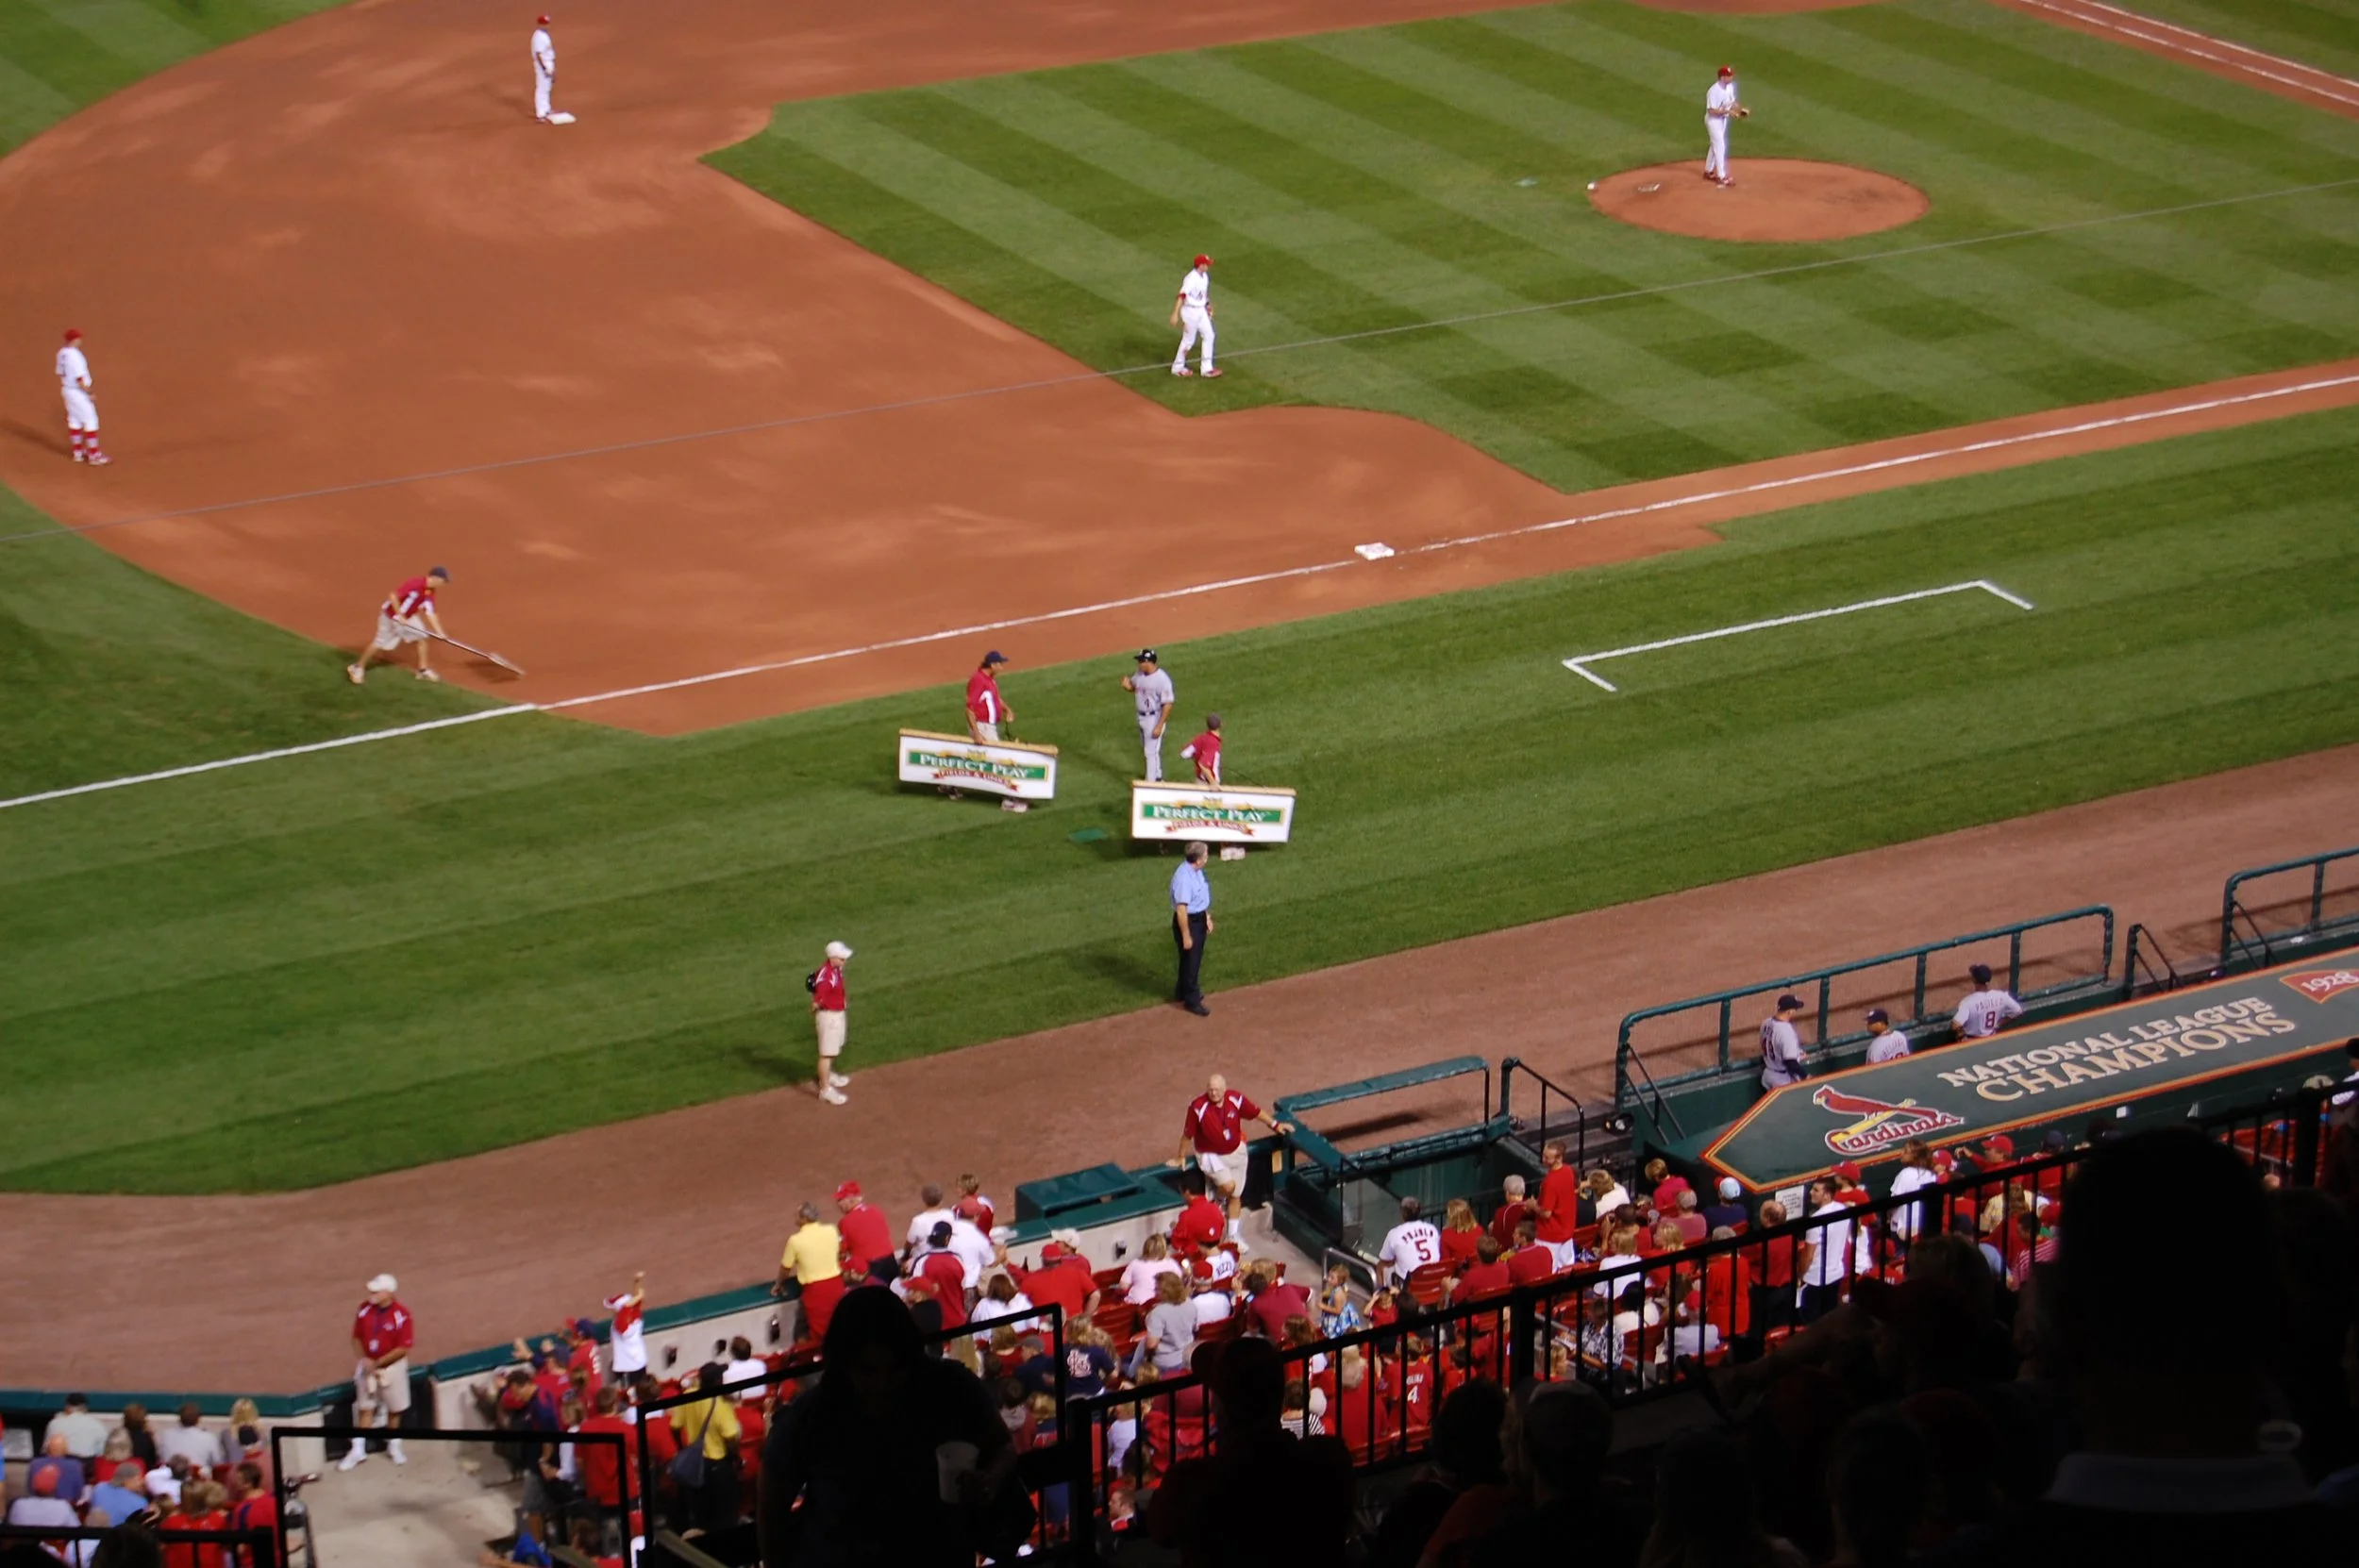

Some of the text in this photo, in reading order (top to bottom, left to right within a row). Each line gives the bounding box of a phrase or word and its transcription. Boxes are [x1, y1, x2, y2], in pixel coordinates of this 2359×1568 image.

[919, 754, 1030, 778] PERFECT PLAY
[1153, 805, 1266, 823] PERFECT PLAY
[2301, 971, 2359, 992] 1928
[1985, 1010, 1996, 1028] 8
[1937, 996, 2272, 1088] NATIONAL LEAGUE
[1976, 1011, 2295, 1102] CHAMPIONS
[1825, 1112, 1965, 1156] Cardinals
[1414, 1239, 1431, 1261] 5
[1407, 1385, 1419, 1404] 4
